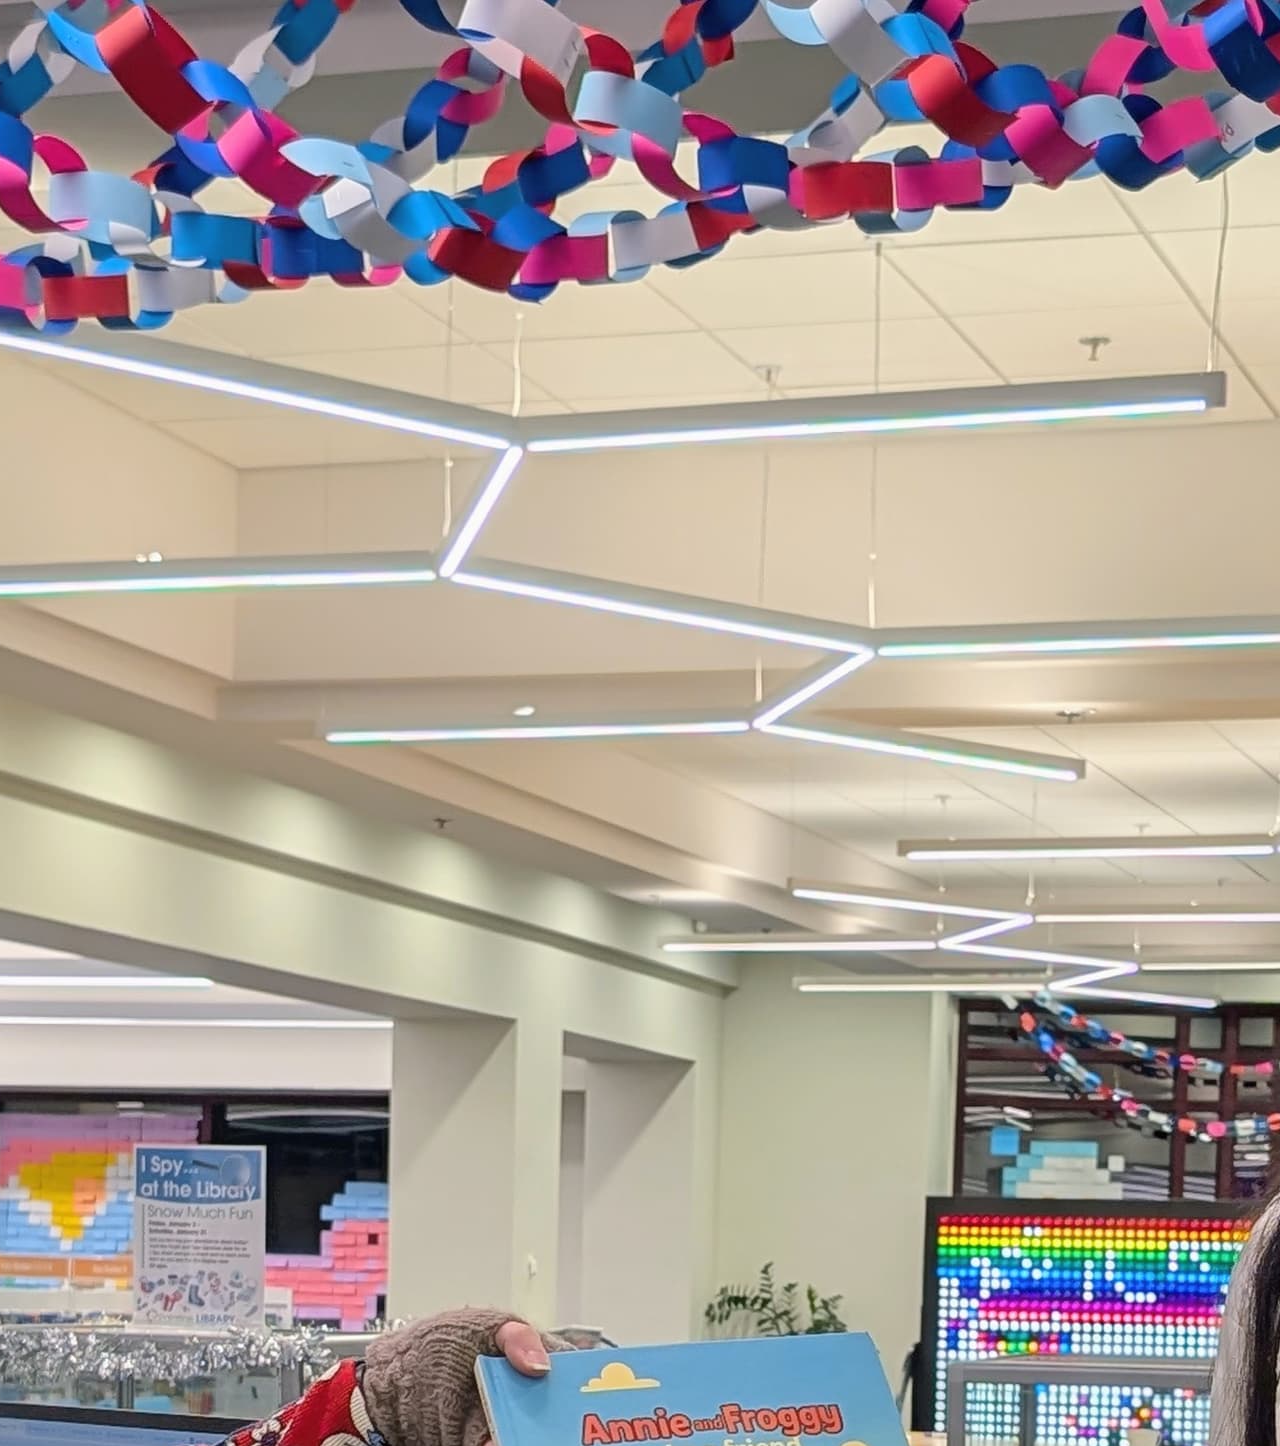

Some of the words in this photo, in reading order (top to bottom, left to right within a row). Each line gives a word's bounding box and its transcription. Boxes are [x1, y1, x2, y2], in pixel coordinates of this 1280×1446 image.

[141, 1157, 146, 1172] I
[141, 1182, 158, 1197] at
[163, 1181, 192, 1198] the
[196, 1181, 257, 1201] Library
[147, 1205, 184, 1218] Snow
[187, 1206, 226, 1219] Much
[582, 1407, 693, 1446] Annie
[694, 1416, 723, 1433] and
[719, 1404, 843, 1437] Froggy
